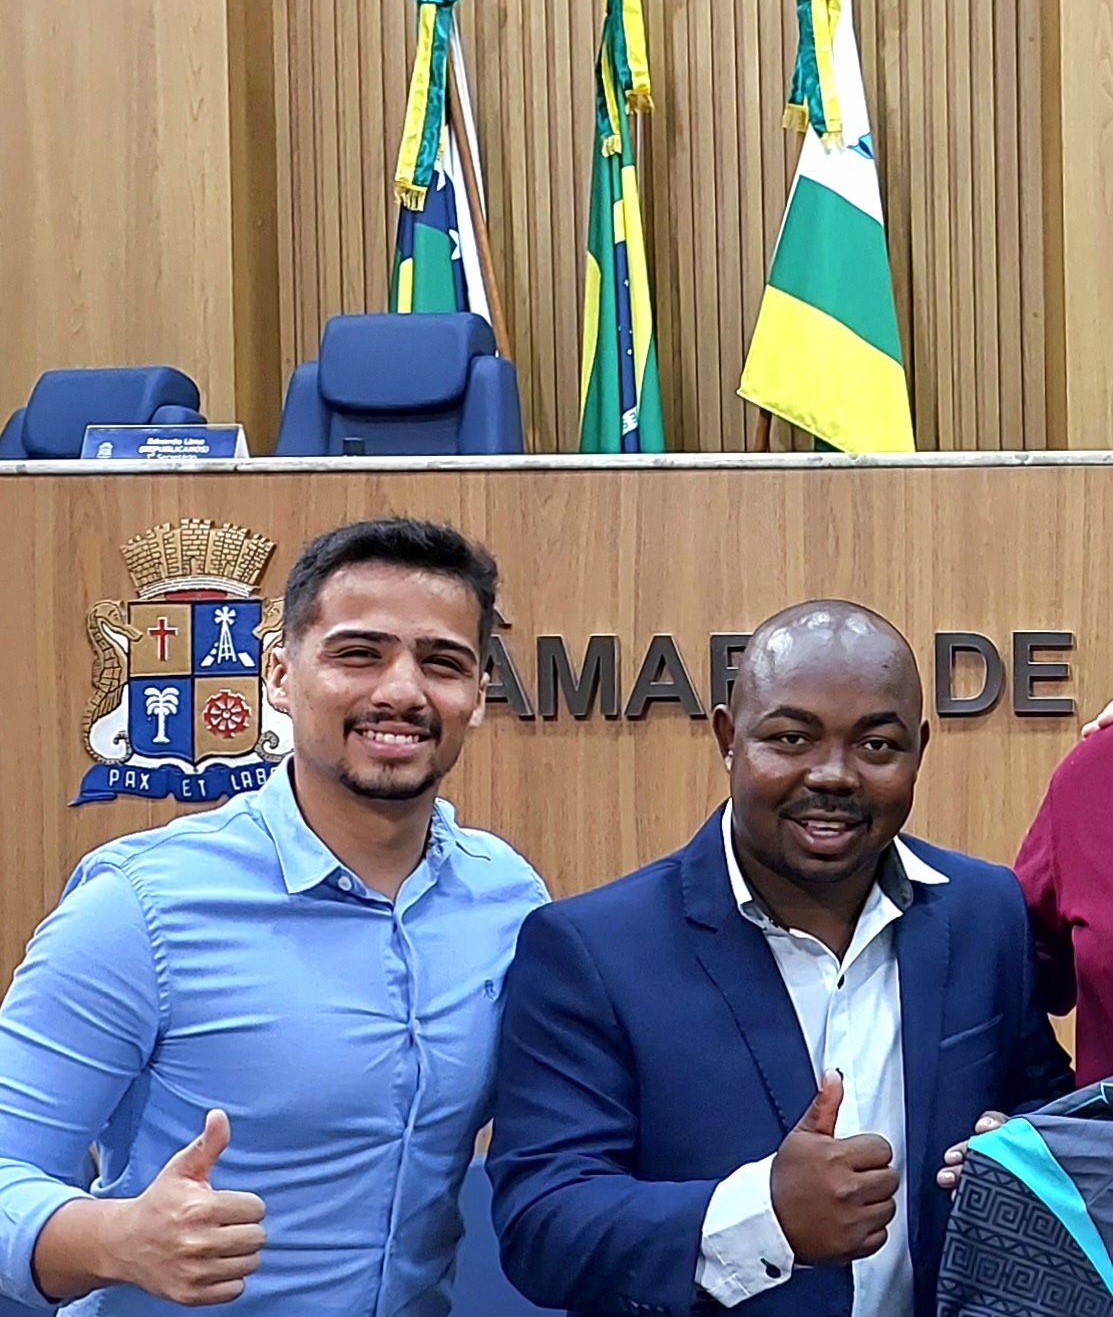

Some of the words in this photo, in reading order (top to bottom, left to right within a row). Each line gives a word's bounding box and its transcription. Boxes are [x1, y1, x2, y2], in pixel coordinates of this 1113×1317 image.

[935, 630, 1076, 716] DE
[108, 768, 150, 790] PAX
[182, 778, 207, 797] ET
[230, 767, 278, 791] LAB
